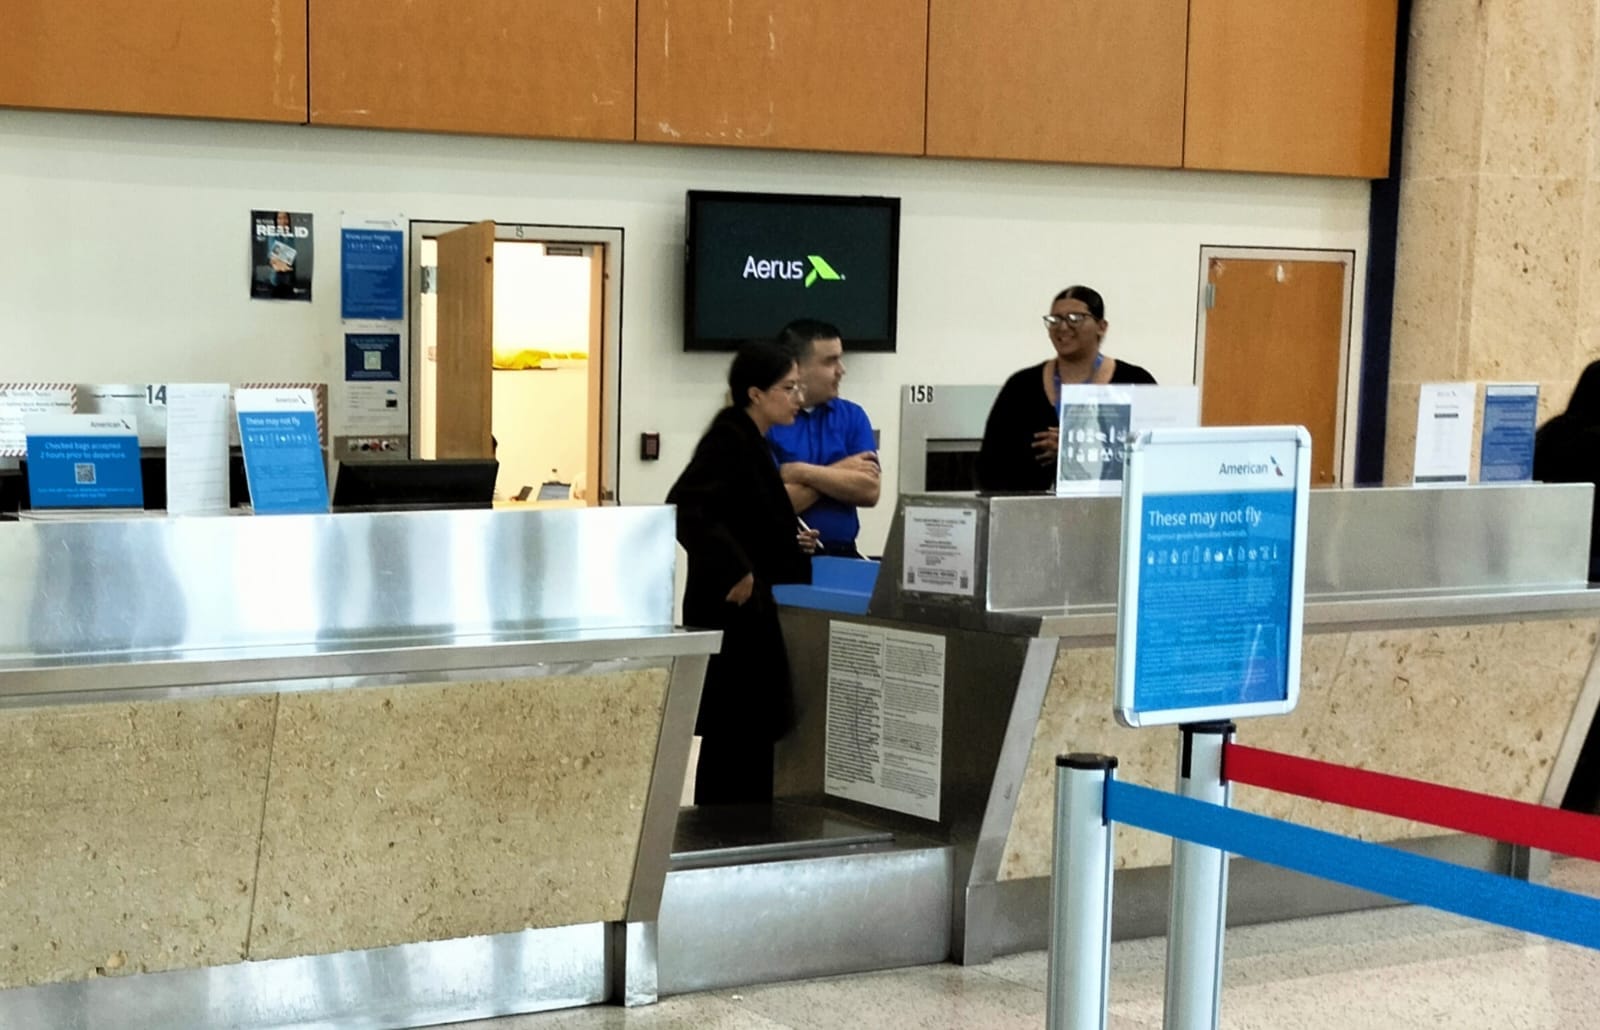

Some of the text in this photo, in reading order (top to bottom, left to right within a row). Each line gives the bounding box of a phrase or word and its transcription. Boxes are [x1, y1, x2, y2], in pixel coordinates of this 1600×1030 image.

[256, 224, 309, 238] REAL ID
[742, 255, 804, 279] Aerus
[146, 384, 167, 405] 14
[910, 384, 934, 403] 15B
[265, 417, 280, 428] may
[279, 416, 292, 426] not
[44, 441, 121, 452] Checked bags accepted
[1218, 461, 1269, 476] American
[1148, 509, 1187, 527] These
[1189, 510, 1218, 529] may
[1219, 508, 1243, 525] not
